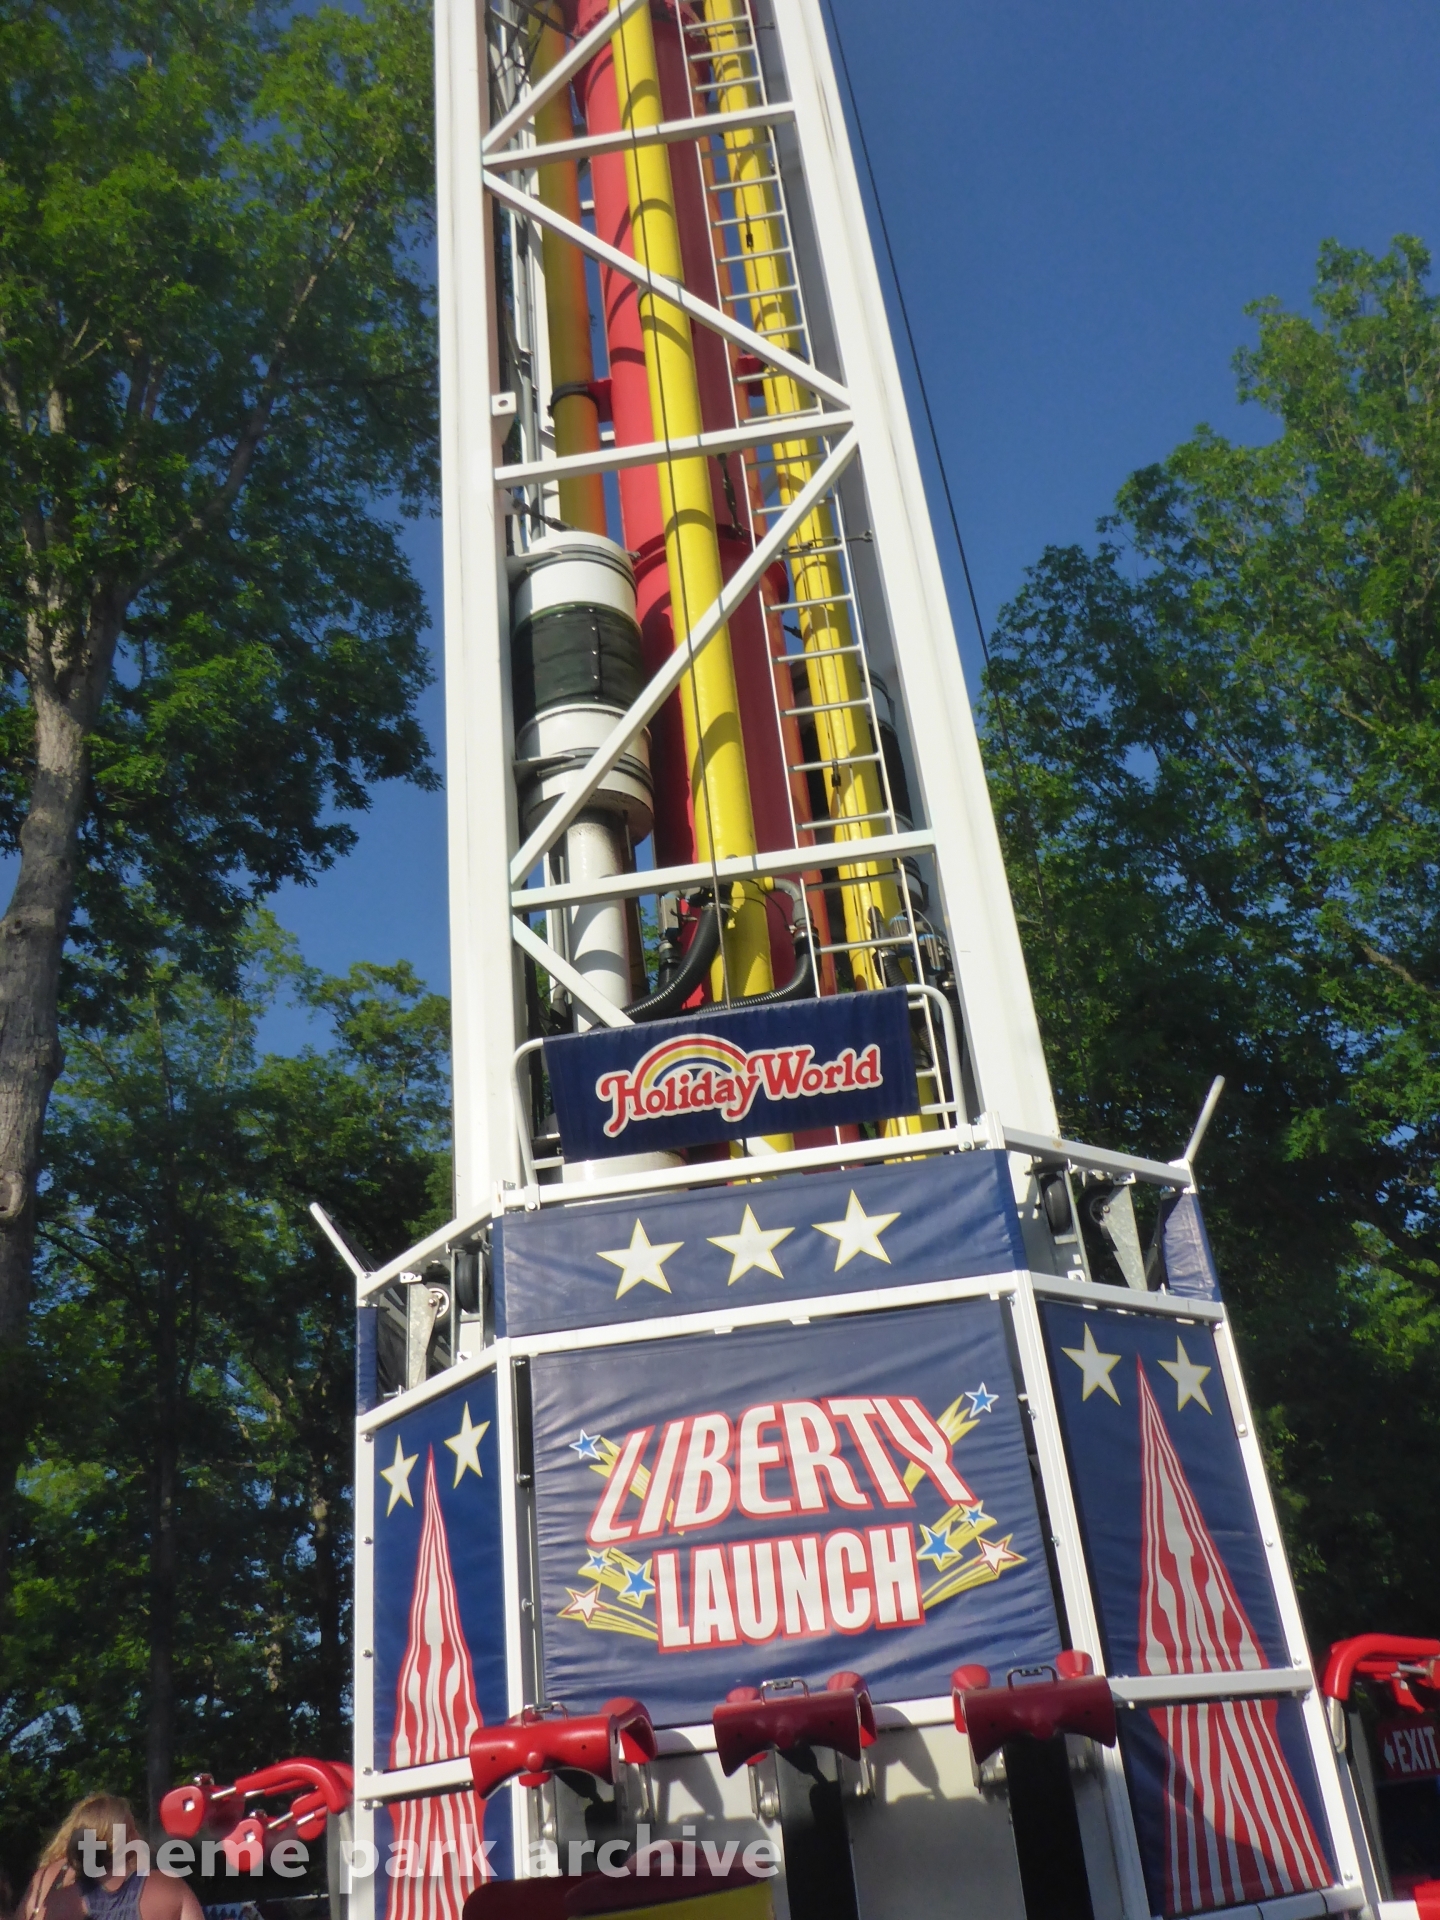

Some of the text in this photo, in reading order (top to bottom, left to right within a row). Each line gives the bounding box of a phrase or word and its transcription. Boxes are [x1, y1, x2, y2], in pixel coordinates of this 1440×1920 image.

[597, 1045, 883, 1136] Holiday World
[589, 1397, 978, 1544] LIBERTY
[656, 1524, 924, 1652] LAUNCH
[1393, 1727, 1440, 1772] EXIT
